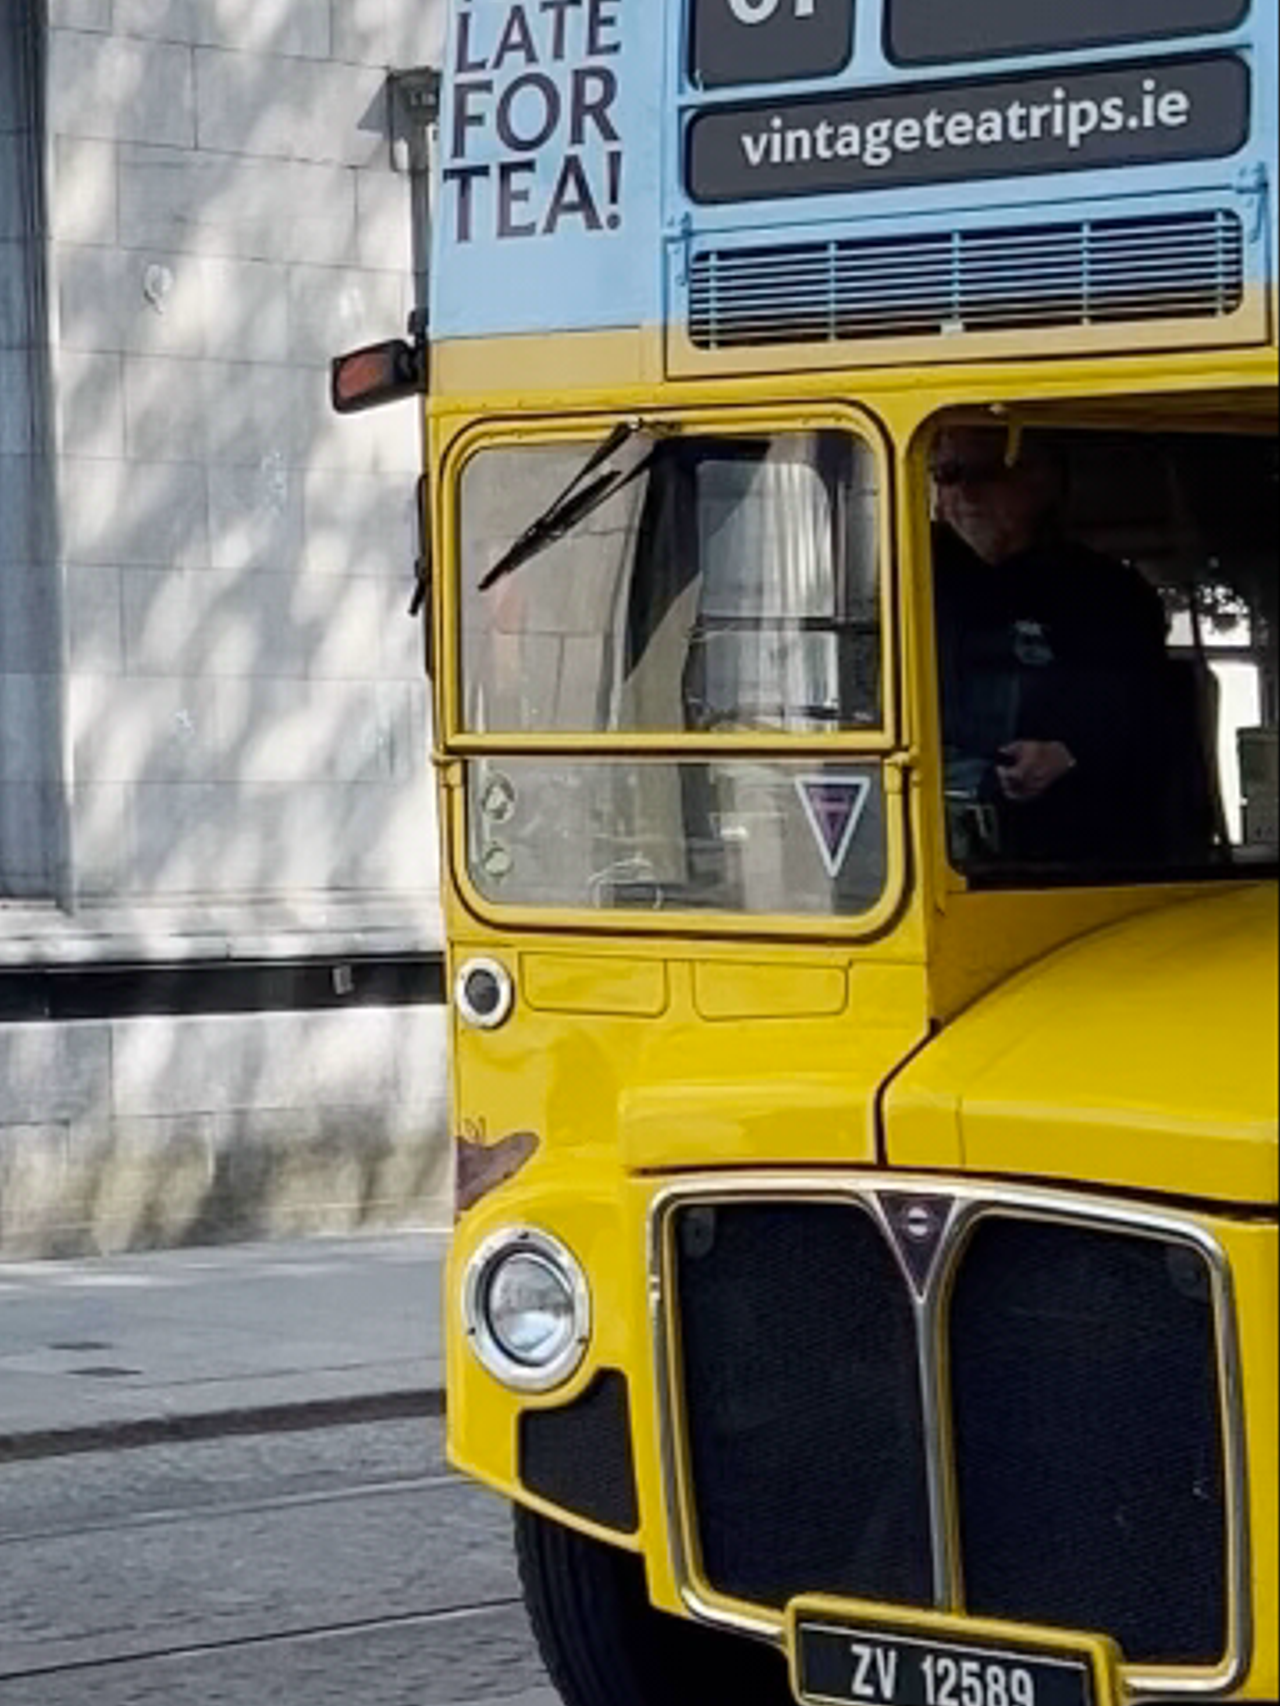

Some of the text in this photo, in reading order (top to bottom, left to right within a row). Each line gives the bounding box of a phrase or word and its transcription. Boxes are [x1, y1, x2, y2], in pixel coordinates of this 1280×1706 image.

[451, 65, 621, 159] FOR
[741, 78, 1191, 167] vintageteatrips.ie
[442, 150, 623, 244] TEA!
[849, 1643, 898, 1700] ZV
